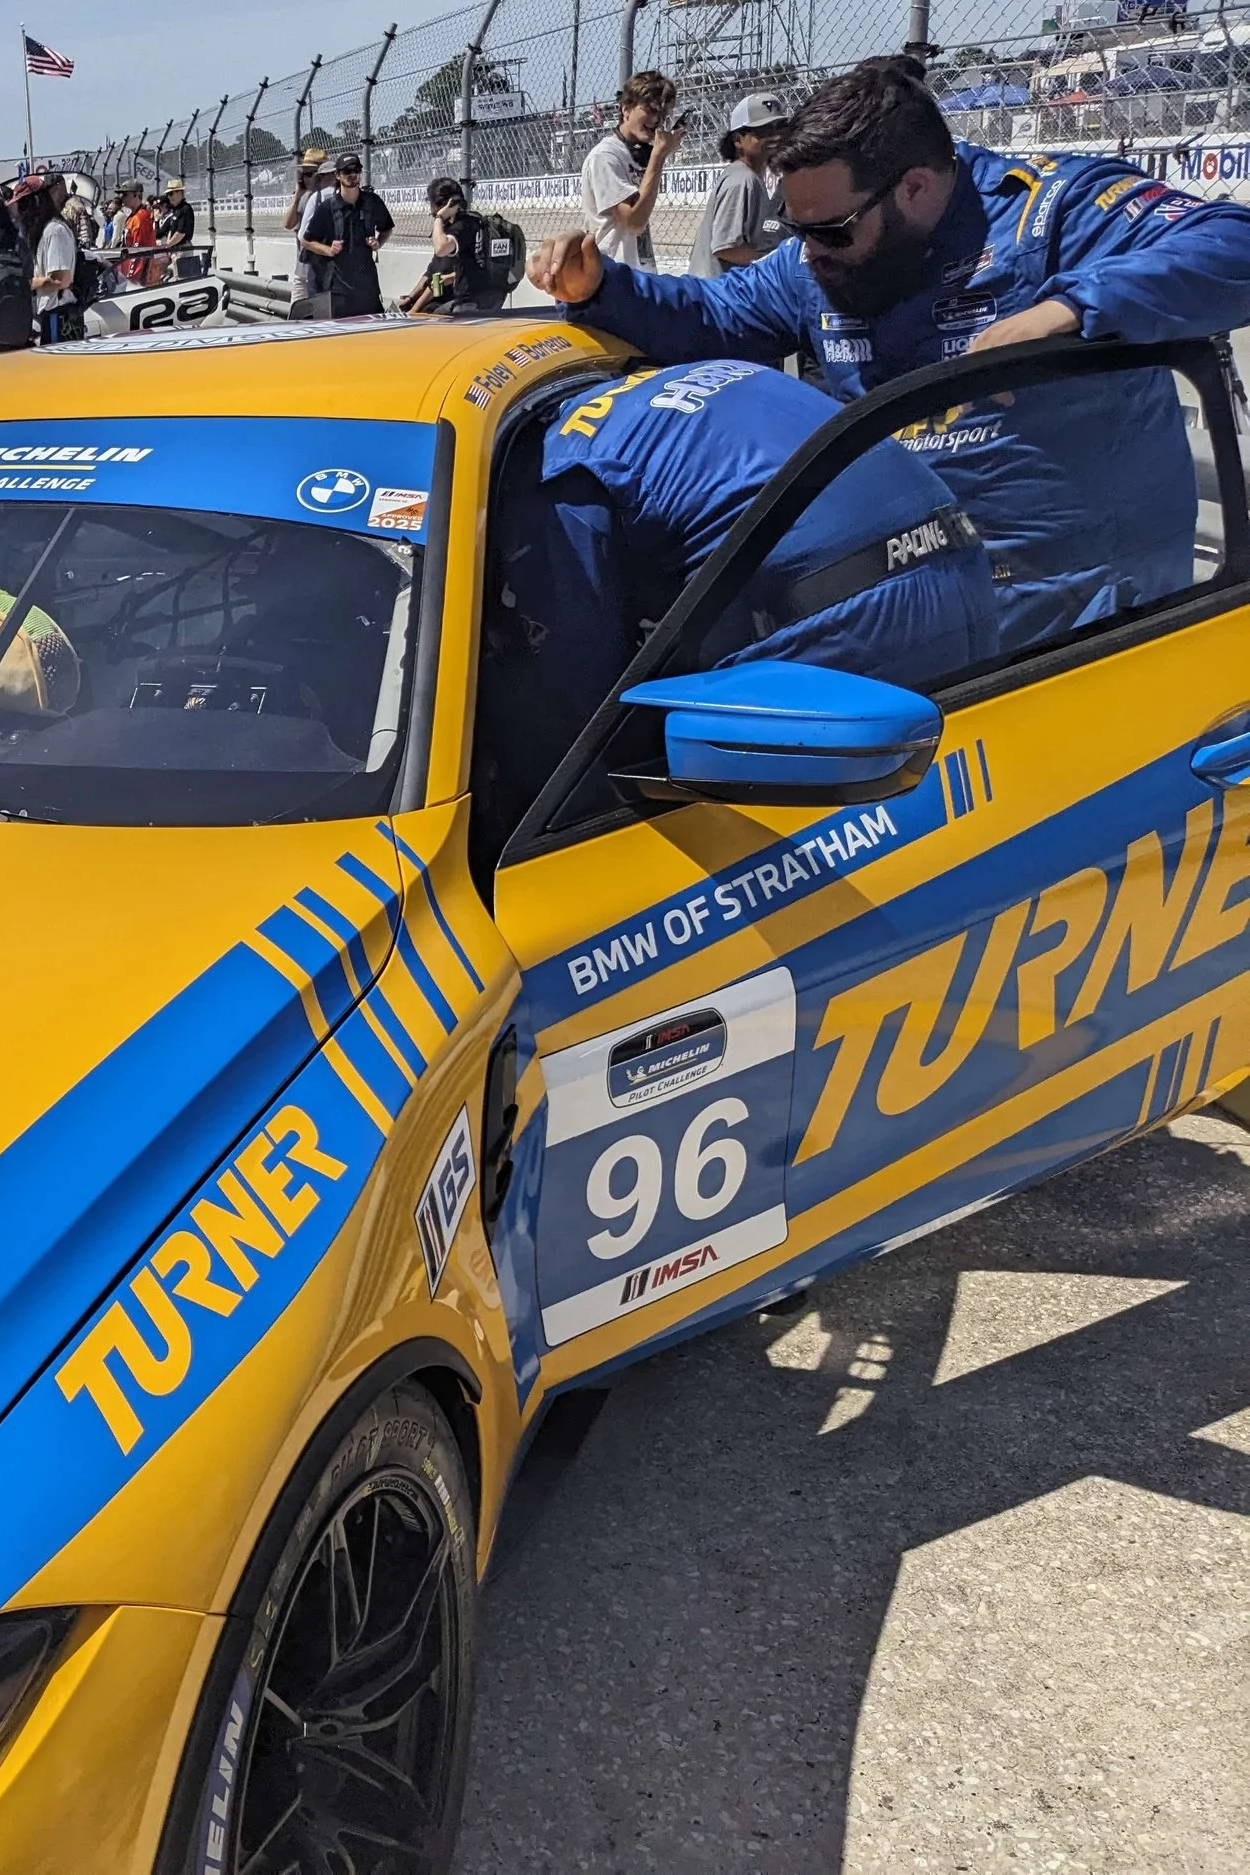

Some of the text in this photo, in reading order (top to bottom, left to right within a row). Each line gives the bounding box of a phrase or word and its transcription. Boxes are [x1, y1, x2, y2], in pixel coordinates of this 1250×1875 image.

[671, 172, 697, 193] Mobil
[493, 243, 508, 251] FAN
[474, 361, 518, 396] Foley
[900, 418, 1003, 454] motorsport
[314, 471, 365, 487] BMW
[367, 517, 422, 530] 2025
[568, 805, 899, 996] BMW OF STRATHAM
[657, 1024, 691, 1044] IMSA
[648, 1043, 710, 1074] MICHELIN
[628, 1064, 708, 1104] PILOT CHALLENGE
[437, 1128, 470, 1229] GS
[586, 1097, 749, 1260] 96
[55, 1104, 348, 1457] TURNER
[651, 1245, 719, 1290] IMSA
[202, 1700, 244, 1875] ELIN
